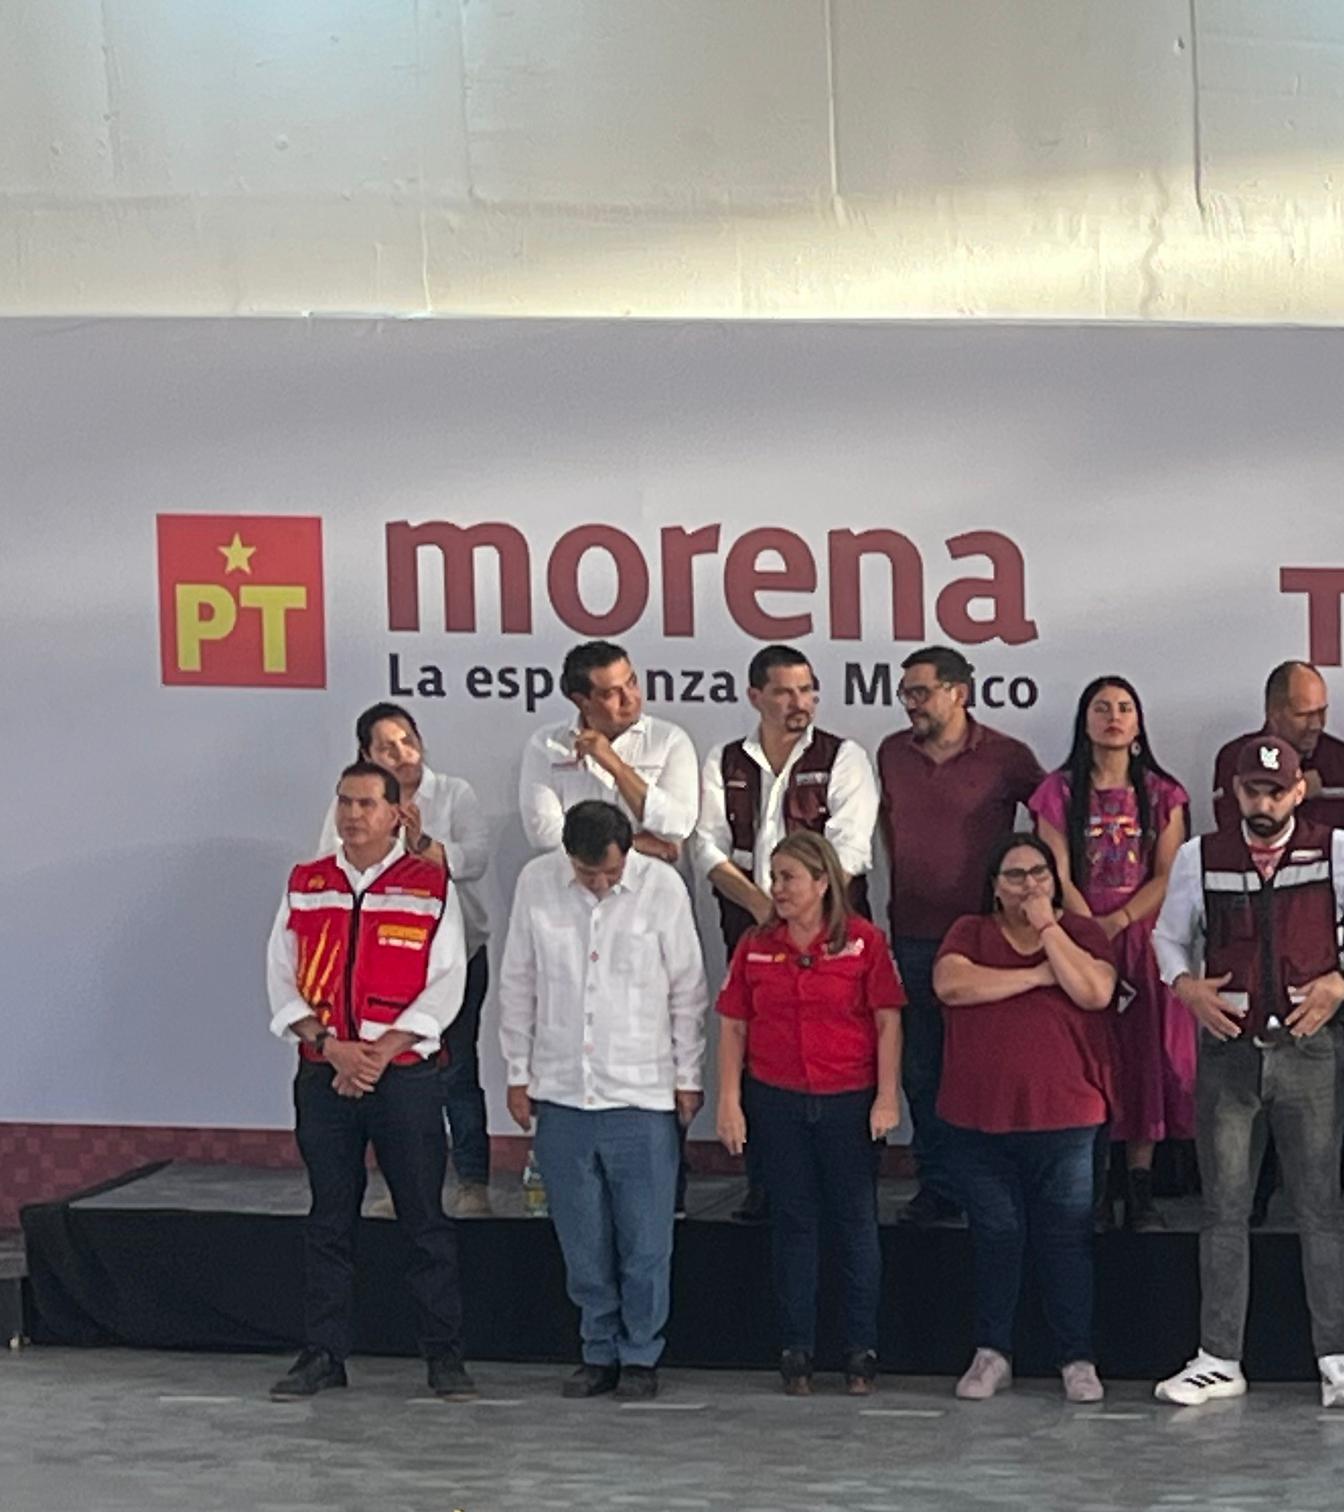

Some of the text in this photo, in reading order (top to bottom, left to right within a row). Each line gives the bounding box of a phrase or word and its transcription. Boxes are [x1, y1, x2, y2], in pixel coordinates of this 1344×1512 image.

[384, 518, 1038, 646] morena
[175, 583, 307, 673] PT
[389, 653, 446, 698] La
[466, 663, 739, 713] espnza
